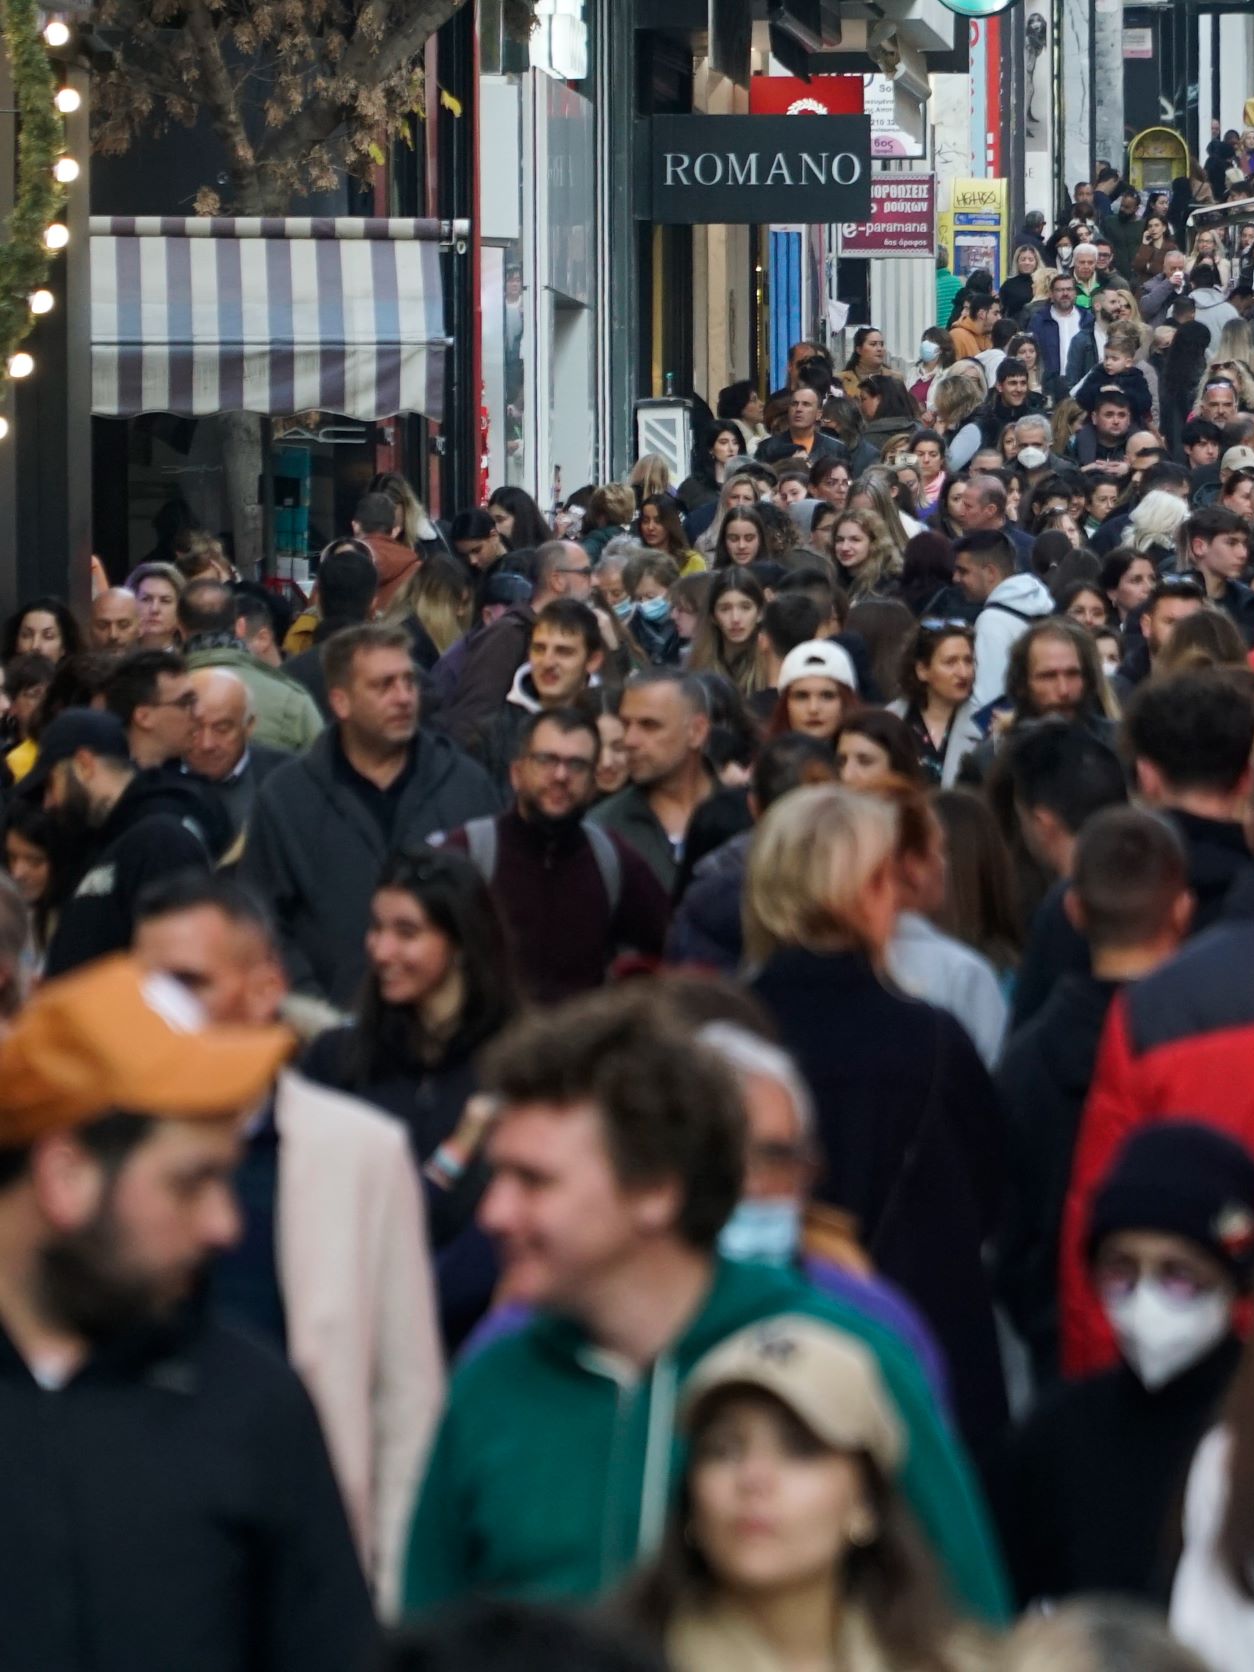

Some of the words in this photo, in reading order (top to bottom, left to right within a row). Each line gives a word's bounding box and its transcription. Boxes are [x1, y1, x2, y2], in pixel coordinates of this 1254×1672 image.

[663, 152, 861, 185] ROMANO
[871, 184, 928, 198] ΙΟΡΘΩΣΕΙΣ
[883, 199, 929, 213] ρούχων
[842, 222, 928, 238] e-paramana
